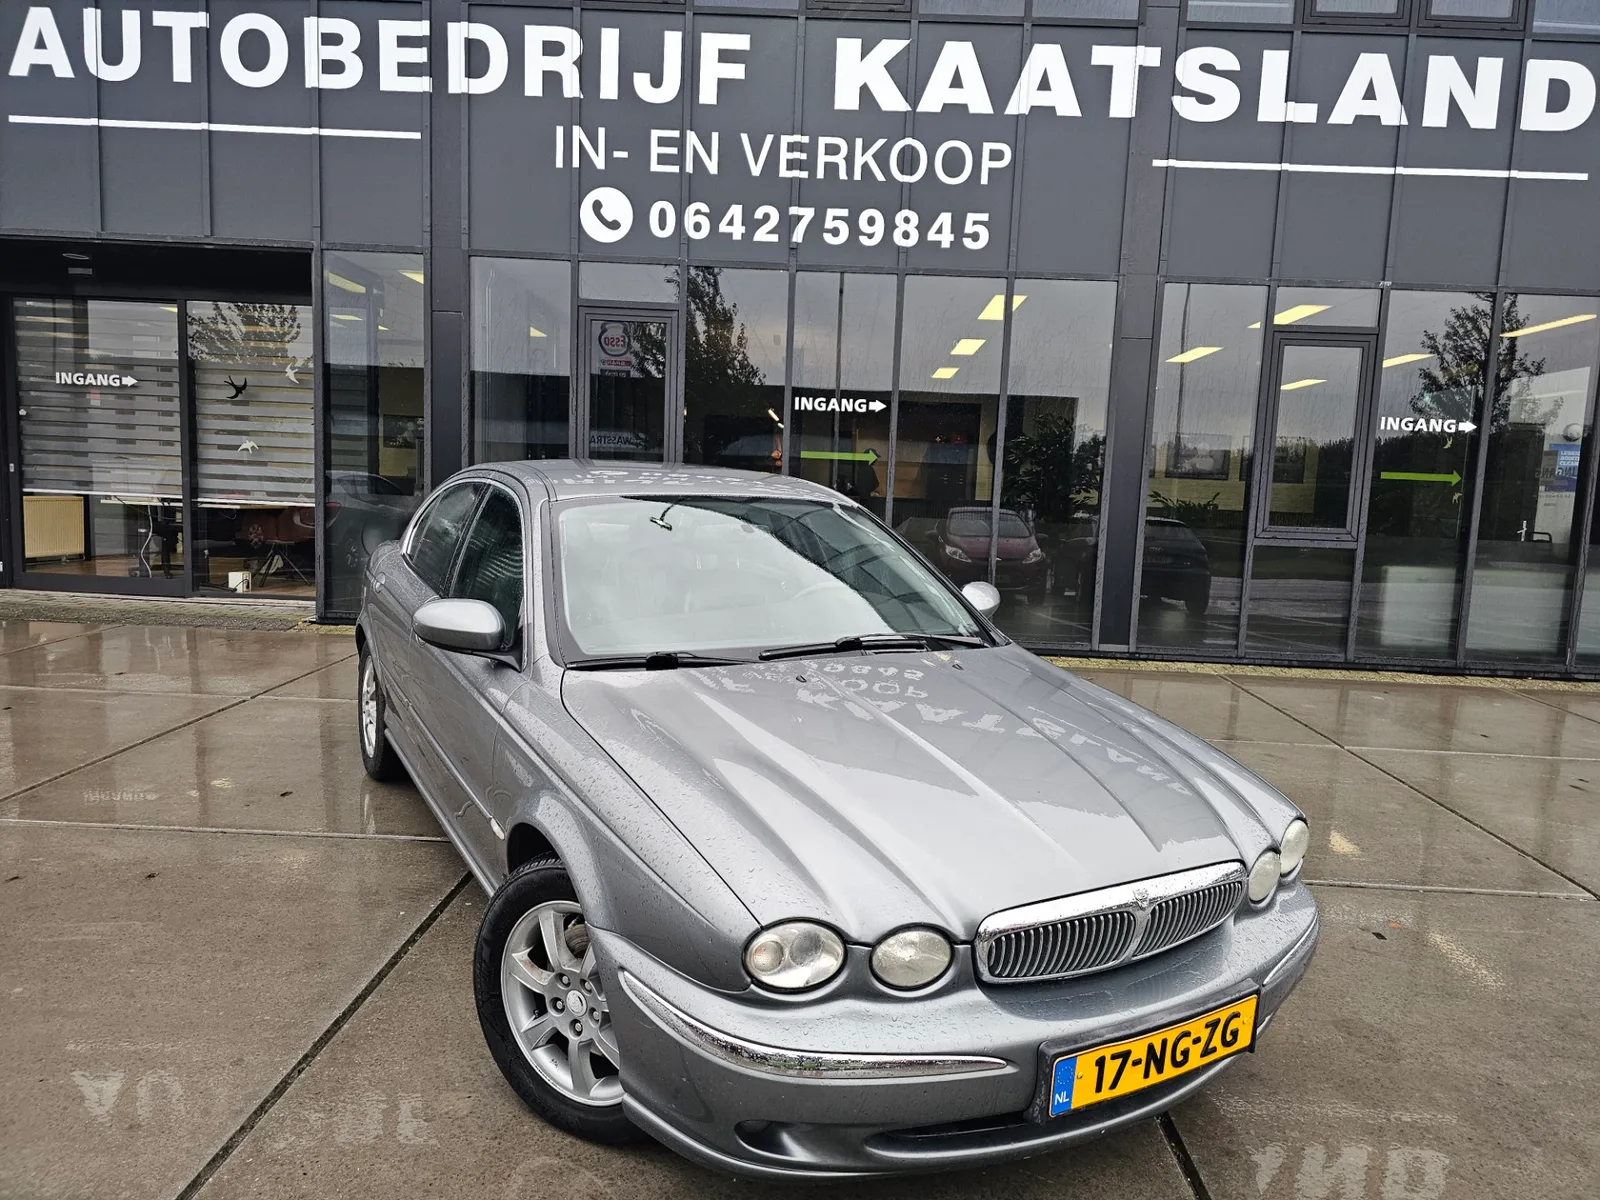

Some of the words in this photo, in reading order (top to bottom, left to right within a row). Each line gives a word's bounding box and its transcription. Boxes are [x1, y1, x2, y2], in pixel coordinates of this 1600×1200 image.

[9, 7, 751, 104] AUTOBEDRIJF
[833, 38, 1597, 131] KAATSLAND
[556, 125, 629, 170] IN-
[650, 128, 719, 175] EN
[741, 133, 1012, 185] VERKOOP
[650, 201, 990, 250] 0642759845
[55, 372, 120, 387] INGANG
[794, 396, 867, 413] INGANG
[1380, 416, 1457, 433] INGANG
[1095, 1012, 1241, 1094] 17-NG-ZG
[1054, 1090, 1070, 1105] NL
